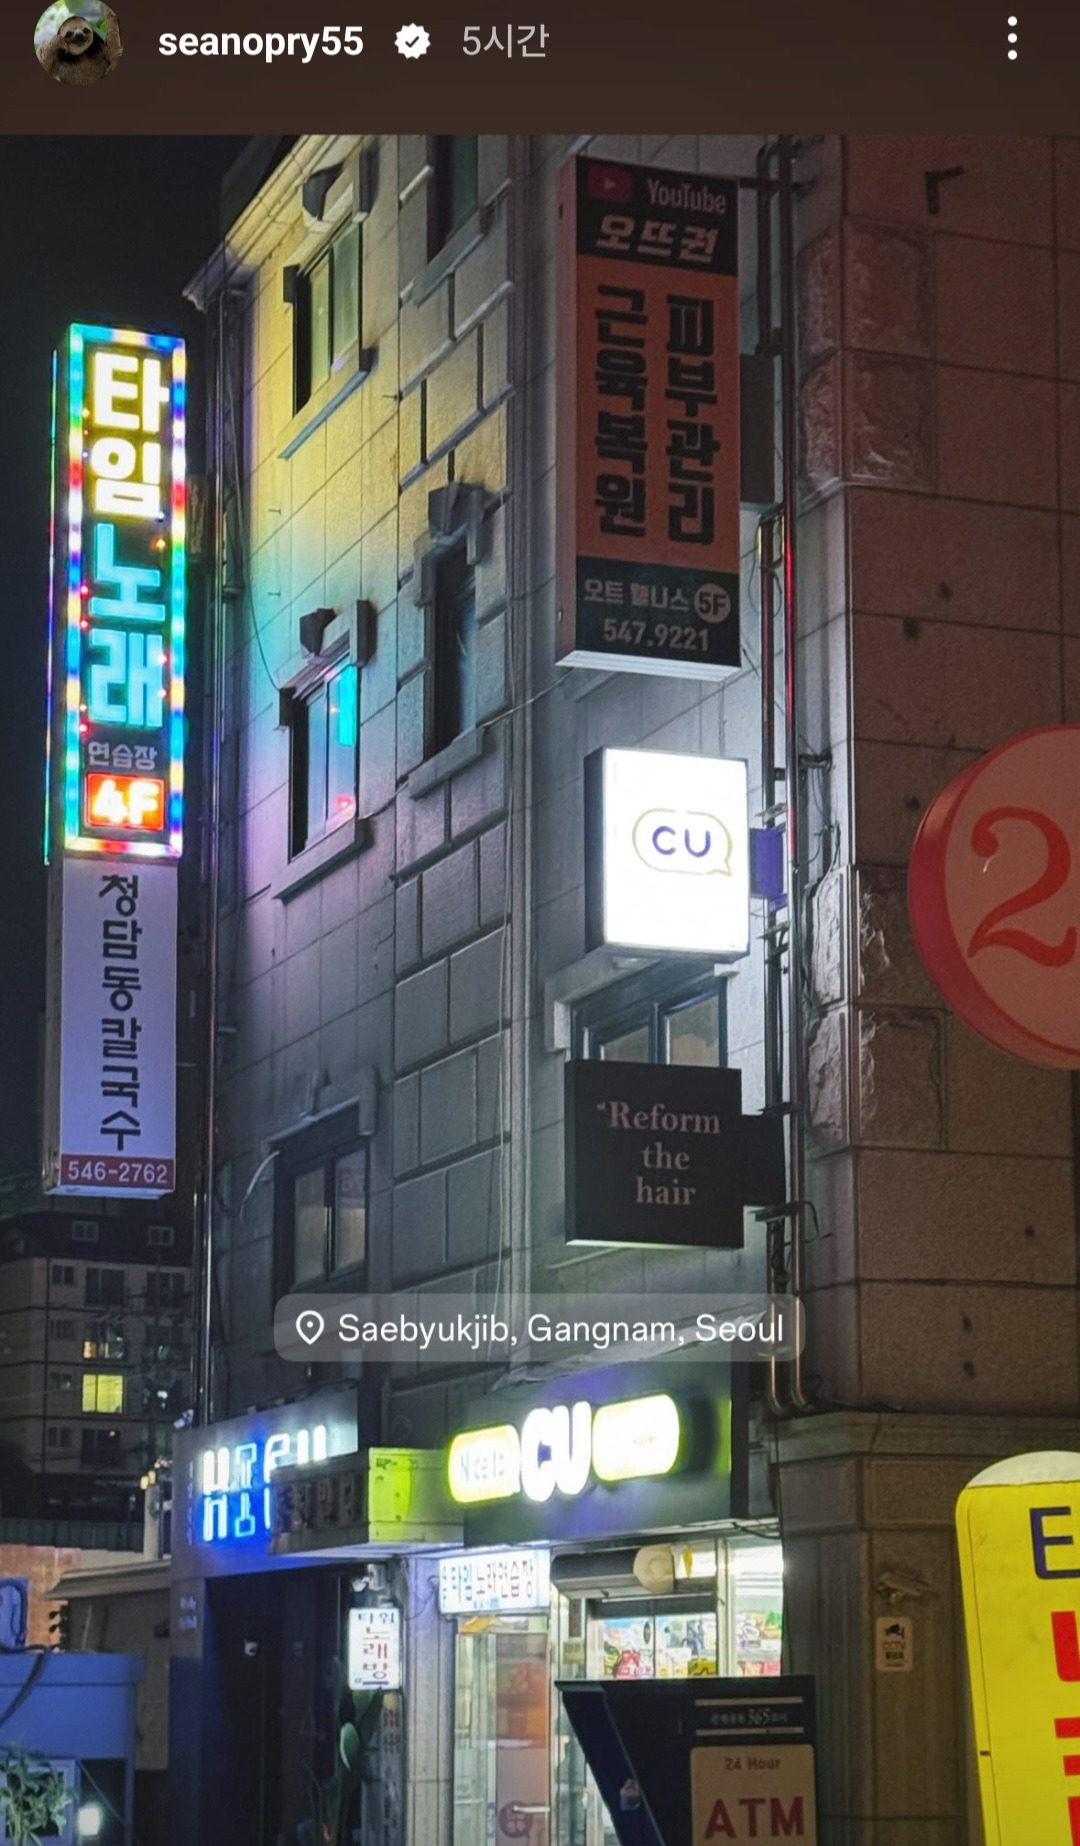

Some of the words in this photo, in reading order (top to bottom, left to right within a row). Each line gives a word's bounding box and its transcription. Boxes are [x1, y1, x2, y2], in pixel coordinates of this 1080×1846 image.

[646, 178, 728, 215] YouTube
[594, 284, 649, 538] 근육복원
[665, 294, 721, 546] 피부관리
[698, 590, 728, 617] 5F
[603, 618, 710, 652] 547.9221
[88, 741, 159, 771] 연습장
[91, 779, 160, 825] 4F
[652, 825, 711, 858] CU
[67, 1158, 168, 1184] 546-2762
[642, 1141, 691, 1170] the
[636, 1176, 697, 1205] hair
[521, 1400, 592, 1502] CU
[724, 1757, 742, 1771] 24
[749, 1757, 781, 1771] Hour
[703, 1796, 805, 1840] ATM
